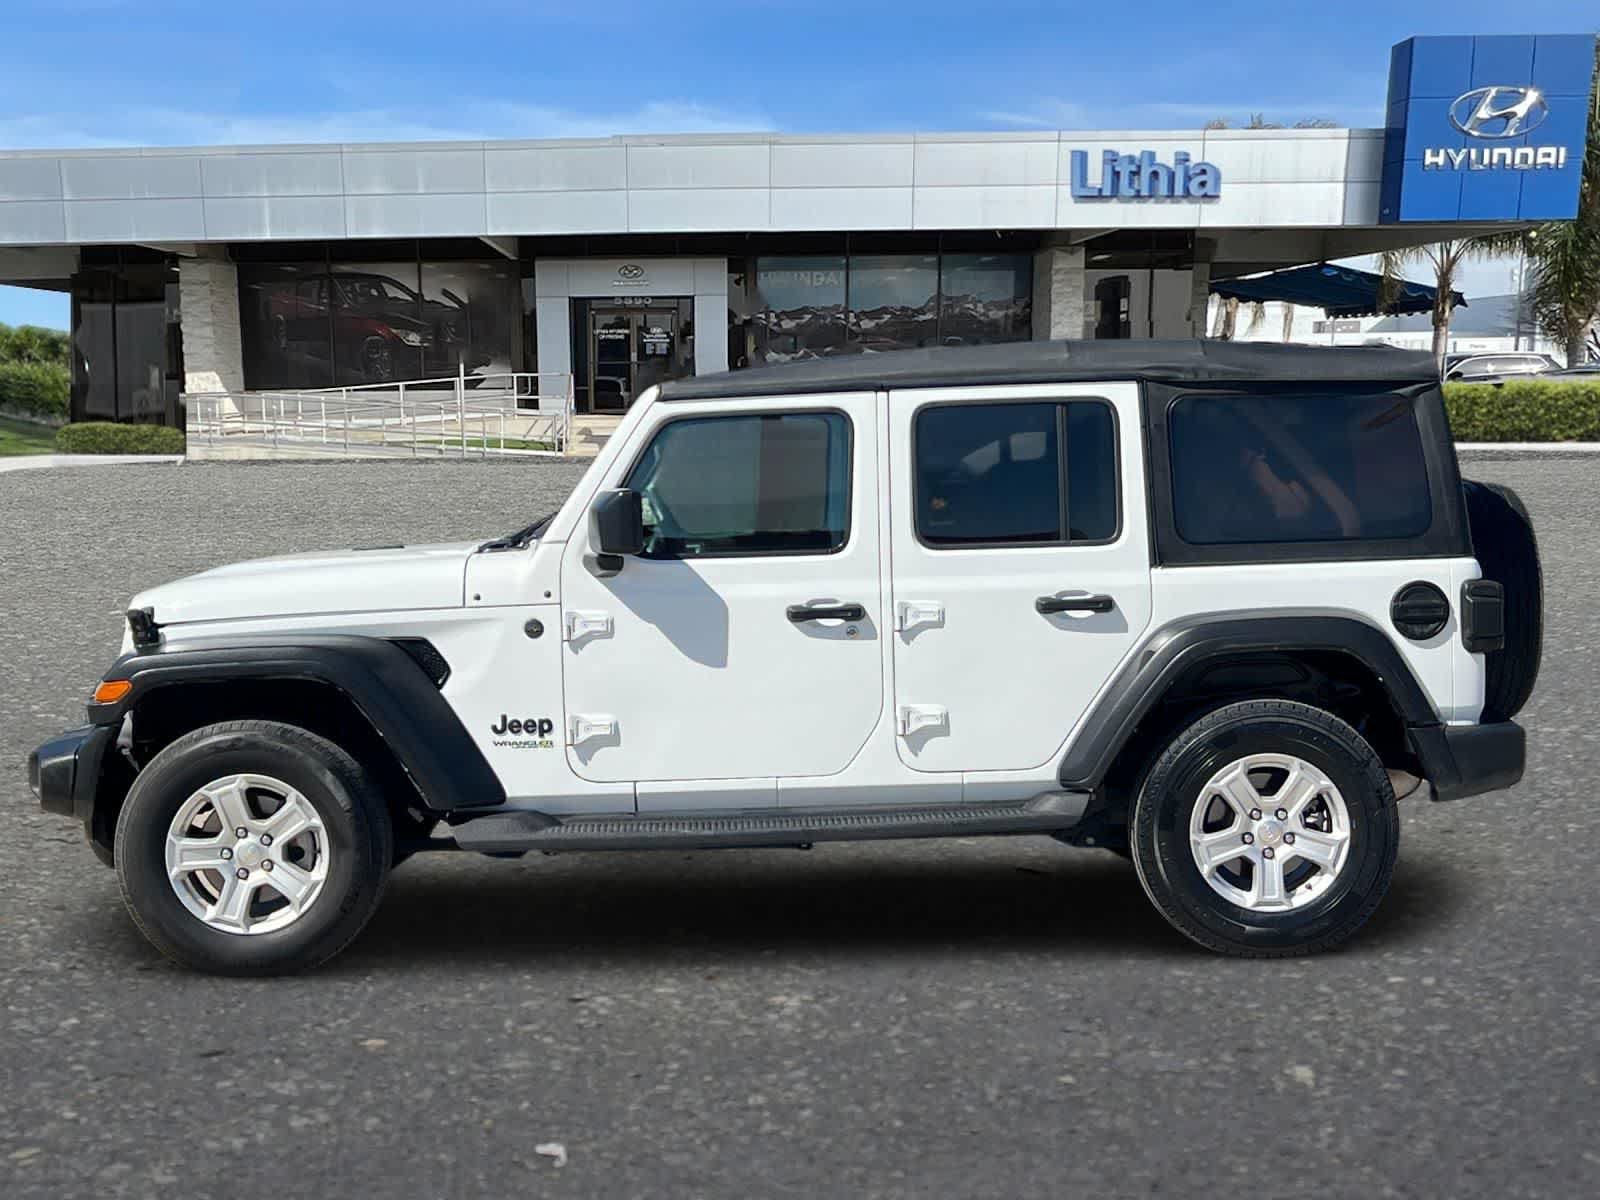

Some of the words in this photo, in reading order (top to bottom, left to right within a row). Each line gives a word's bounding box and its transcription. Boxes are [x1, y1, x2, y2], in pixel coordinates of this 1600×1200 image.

[1423, 146, 1567, 170] HYUNDAI
[1071, 150, 1222, 201] Lithia
[491, 714, 553, 738] Jeep
